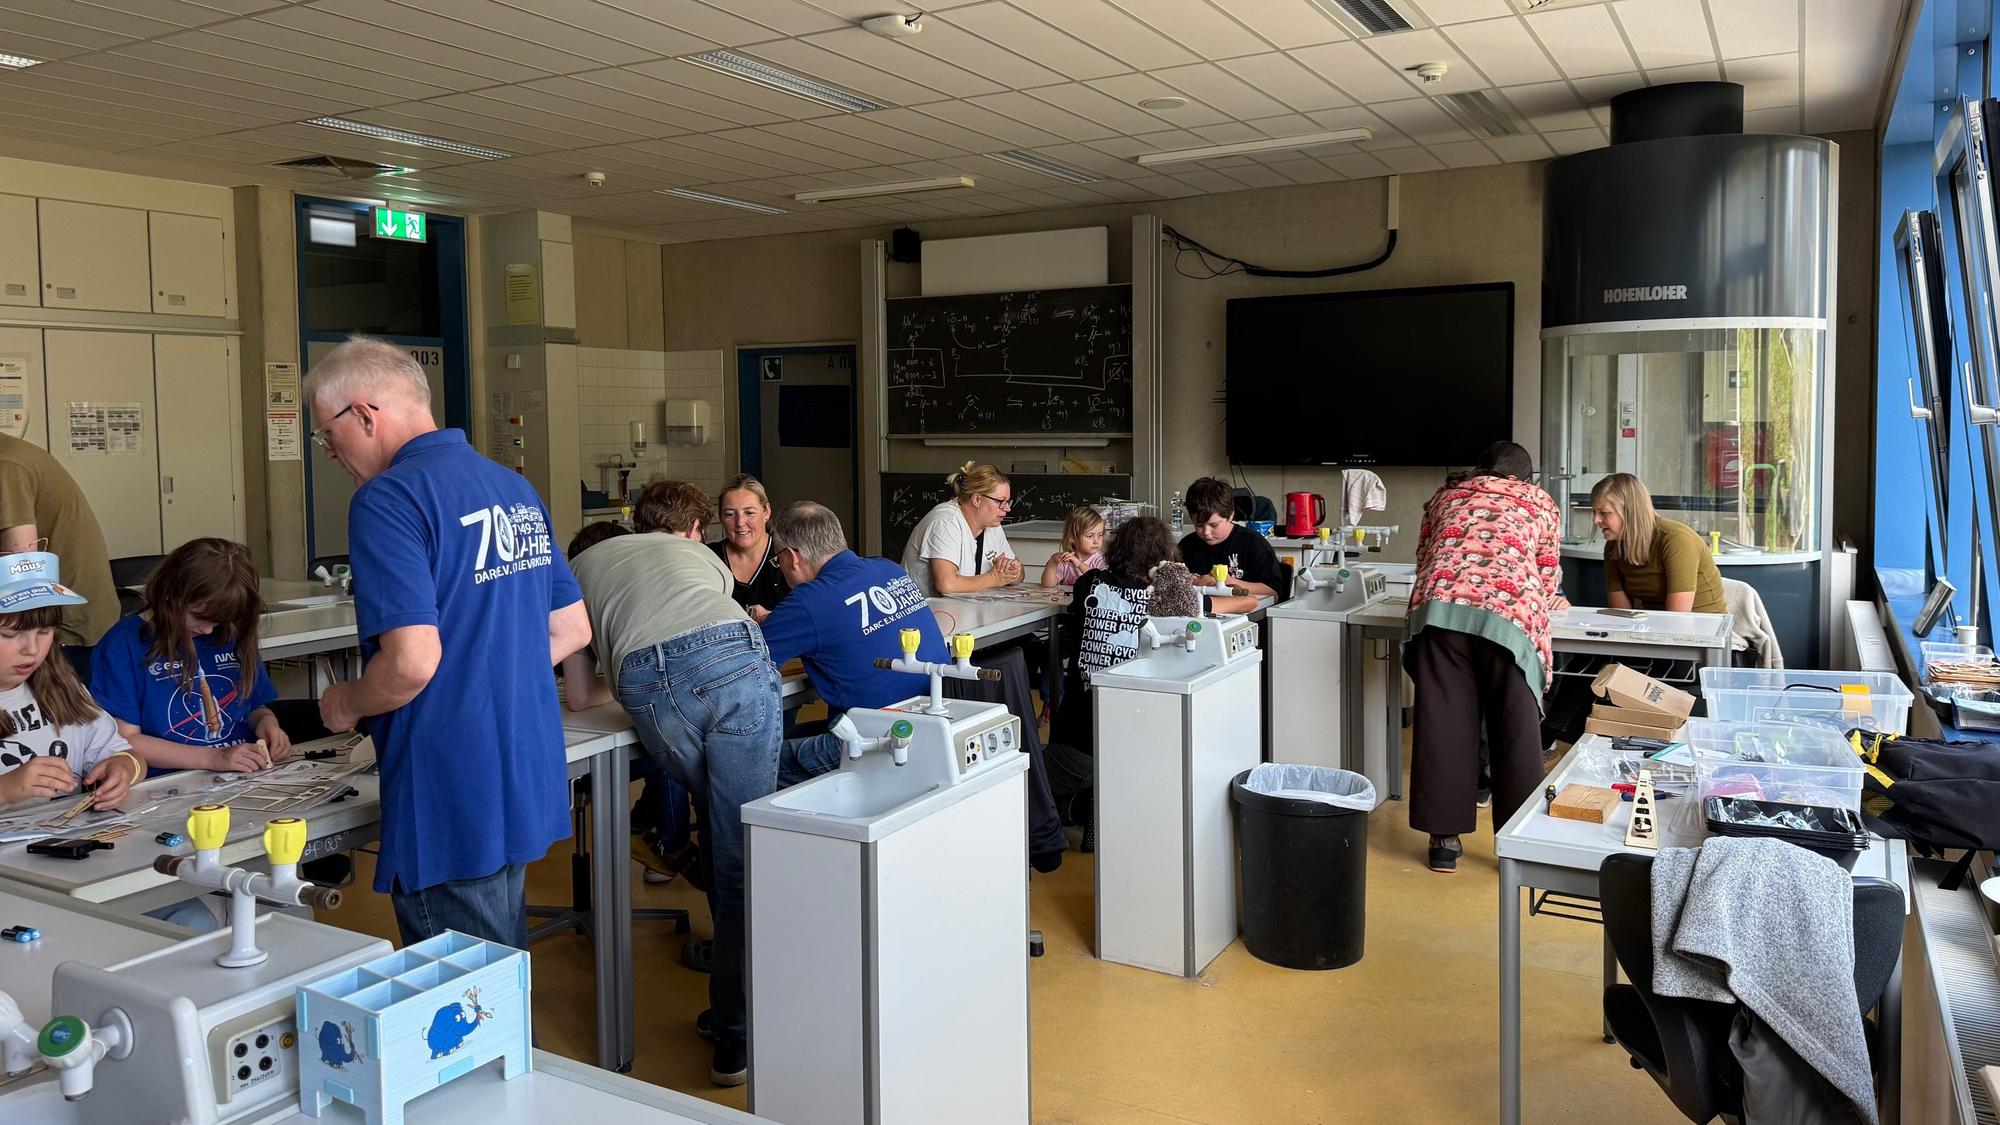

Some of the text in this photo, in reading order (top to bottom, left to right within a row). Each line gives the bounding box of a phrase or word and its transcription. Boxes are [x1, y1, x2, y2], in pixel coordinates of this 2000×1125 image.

[1603, 285, 1687, 303] HOHENLOHER
[459, 504, 514, 571] 70
[9, 561, 42, 575] Maus
[844, 585, 897, 629] 70
[1086, 606, 1118, 621] POWER
[862, 620, 884, 636] DARC
[1084, 617, 1117, 632] POWER
[1082, 629, 1112, 643] POWE
[1081, 639, 1114, 655] POWER
[1079, 651, 1111, 666] POWER
